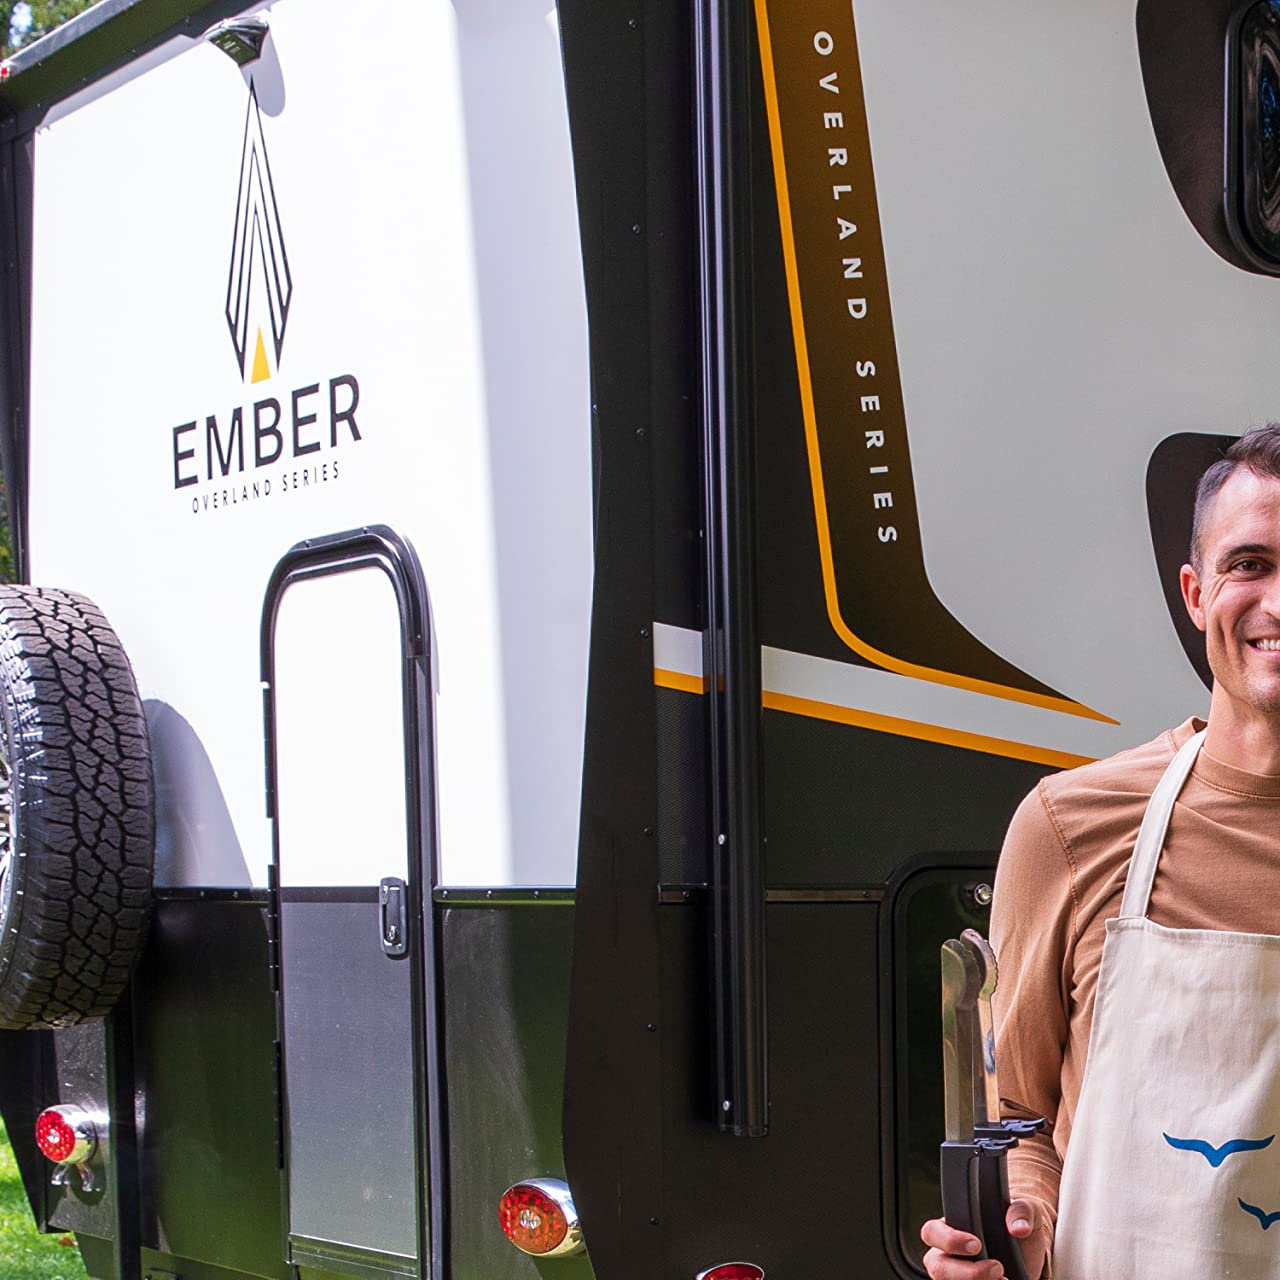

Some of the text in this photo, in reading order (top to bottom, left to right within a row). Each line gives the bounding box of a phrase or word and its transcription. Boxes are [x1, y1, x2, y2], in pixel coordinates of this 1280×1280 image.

[813, 31, 897, 543] OVERLAND SERIES
[173, 374, 362, 490] EMBER
[192, 461, 339, 514] OVERLAND SERIES
